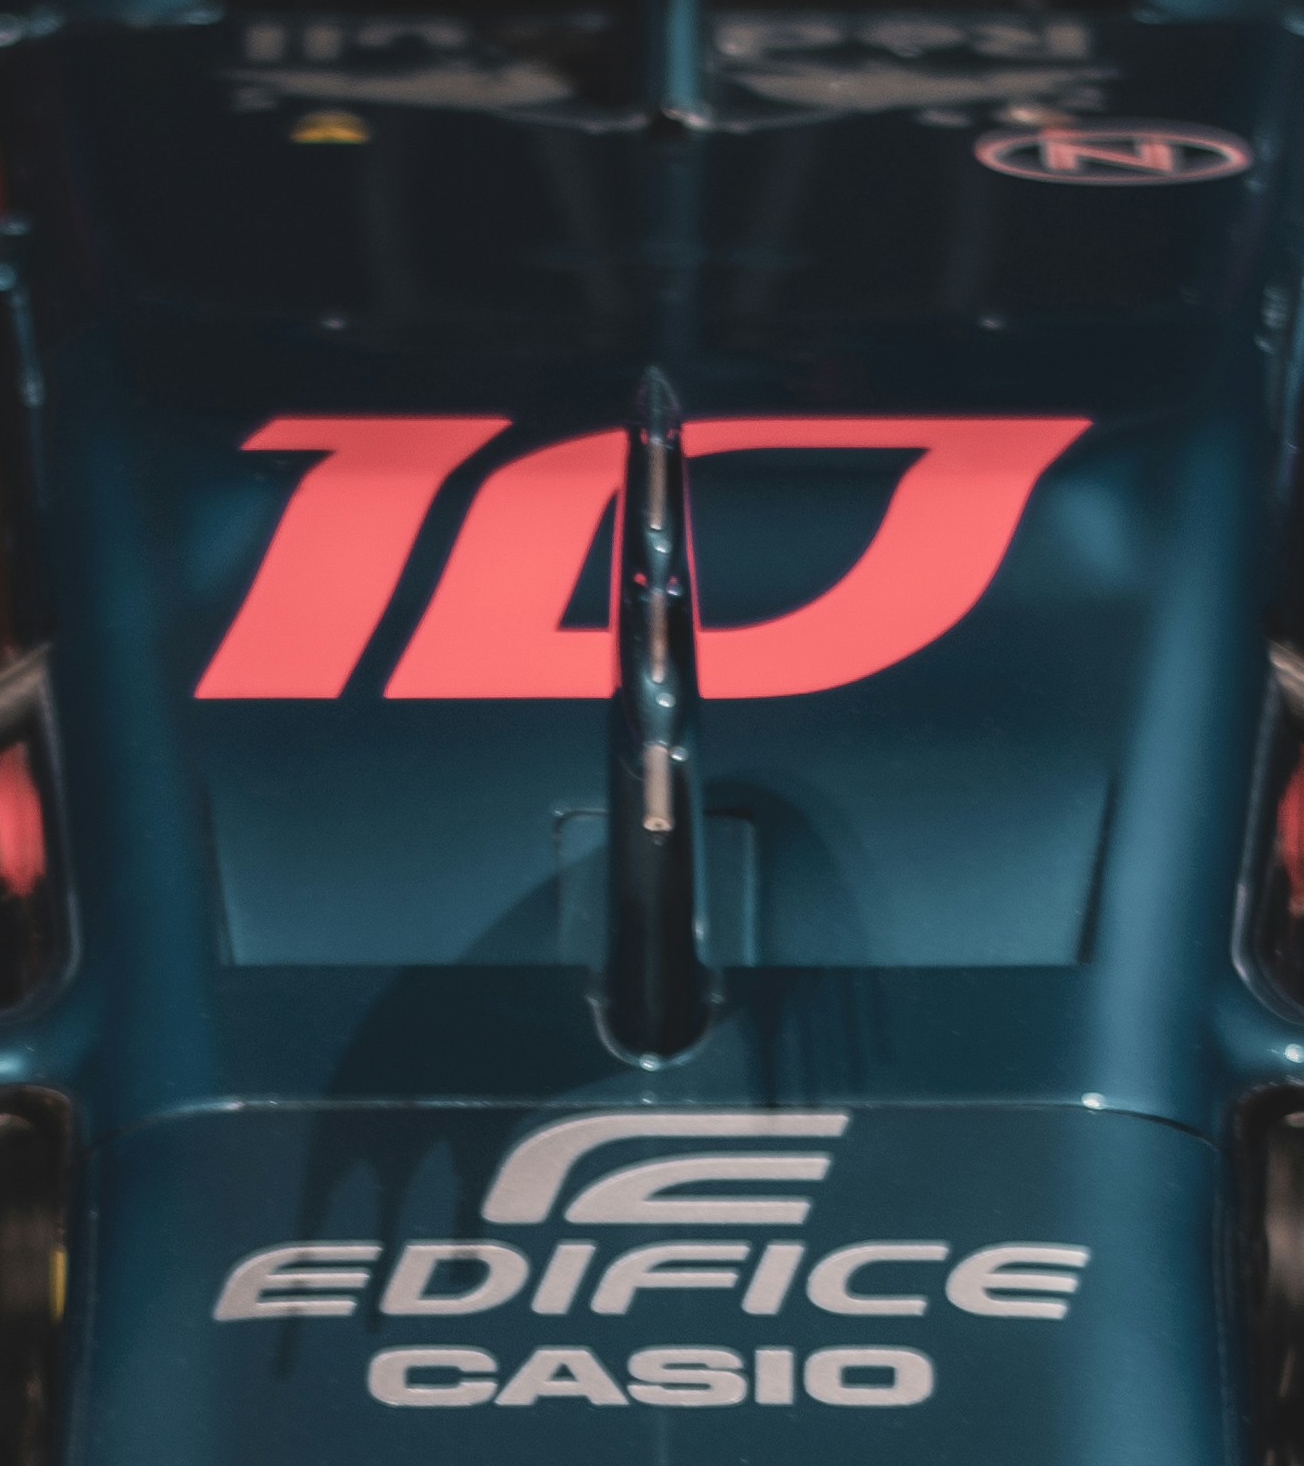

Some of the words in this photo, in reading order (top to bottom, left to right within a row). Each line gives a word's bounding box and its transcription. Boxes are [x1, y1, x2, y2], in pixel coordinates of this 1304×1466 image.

[193, 413, 1093, 699] 10
[211, 1239, 1093, 1322] EDIFICE
[365, 1345, 936, 1408] CASIO
